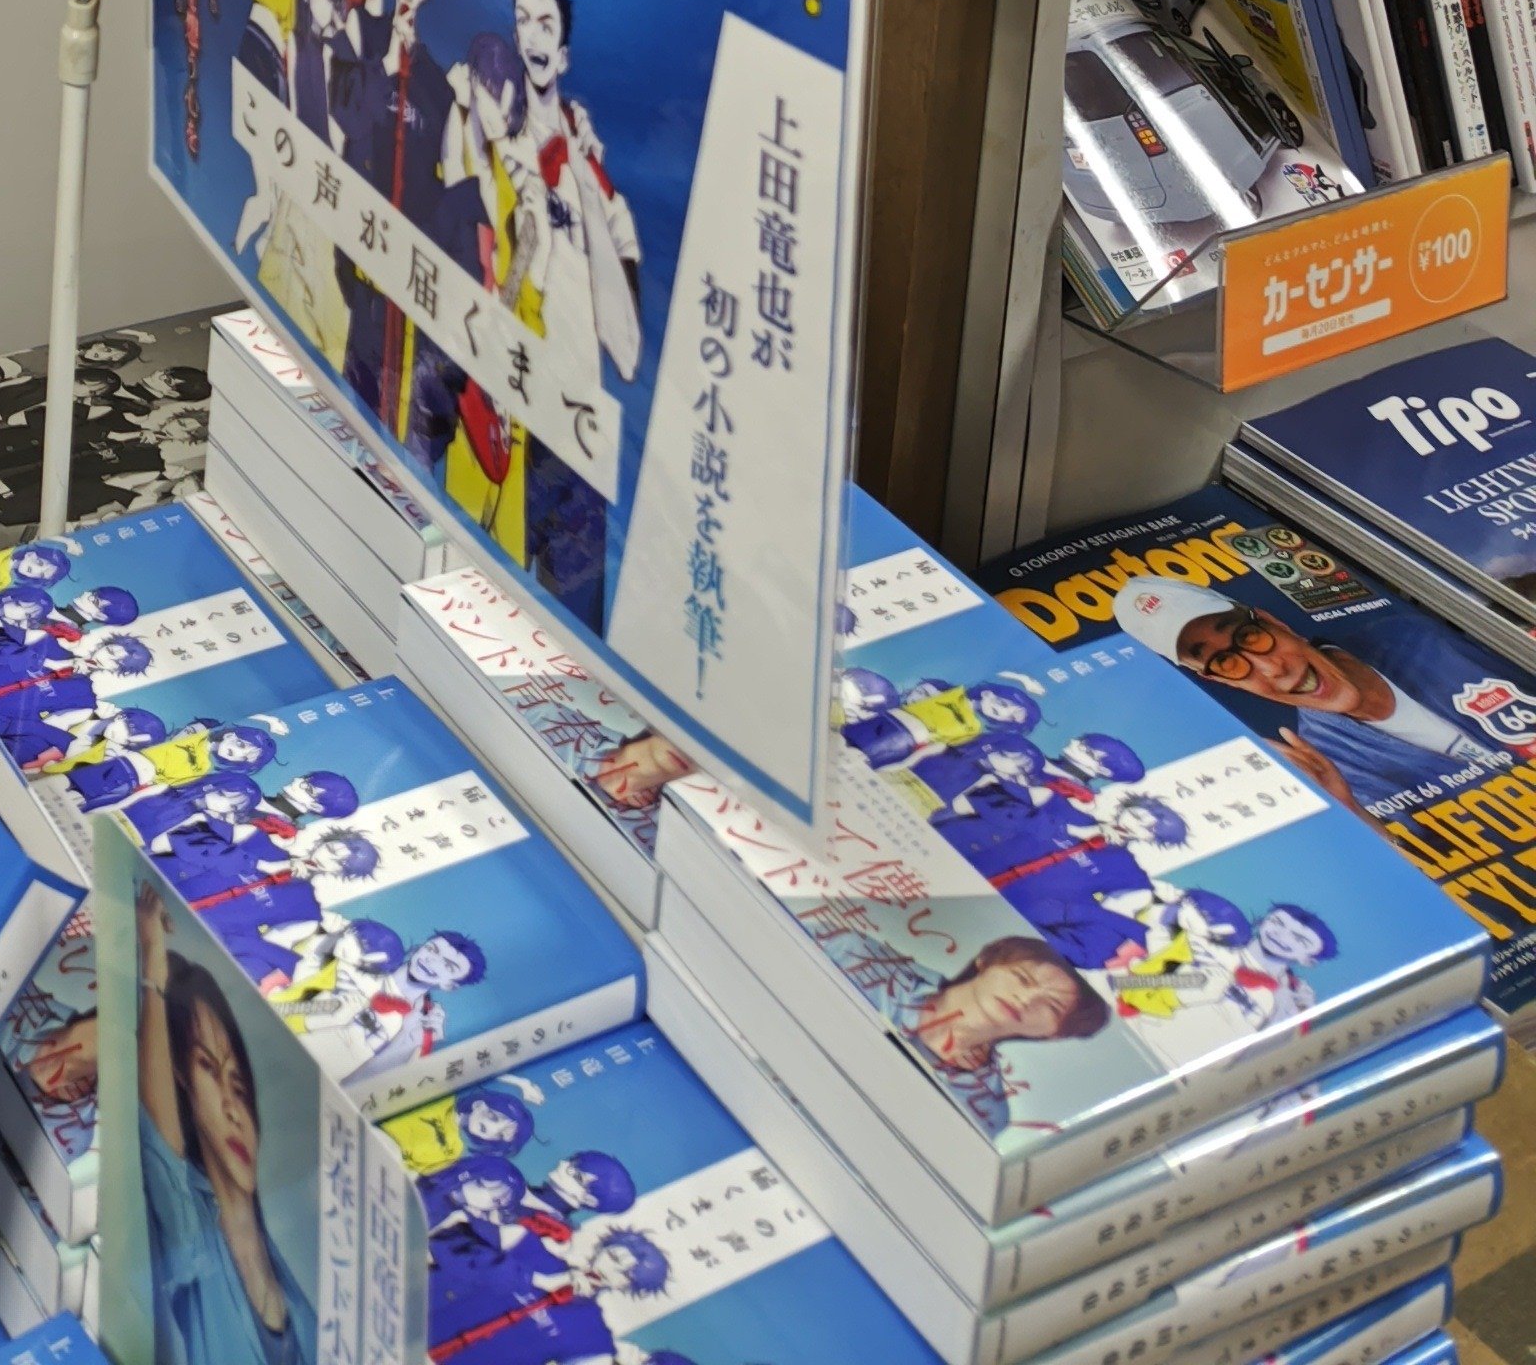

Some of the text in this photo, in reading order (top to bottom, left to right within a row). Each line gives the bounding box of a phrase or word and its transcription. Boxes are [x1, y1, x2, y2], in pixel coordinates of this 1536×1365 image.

[749, 95, 804, 373] 上田竜也が
[240, 93, 599, 463] この声が届くまで
[1262, 243, 1394, 327] カーセンサー
[1300, 312, 1356, 340] 毎月20日発売
[1366, 387, 1521, 457] Tipo
[685, 271, 741, 700] 初の小説を執筆!
[1087, 520, 1150, 549] SETAGAYA
[1146, 514, 1182, 533] BASE
[1476, 688, 1506, 712] ROUTE
[1496, 703, 1536, 733] 66
[377, 782, 486, 836] 届くまで
[1364, 749, 1516, 821] ROUTE 66 Road Trip
[397, 809, 522, 867] この声が
[662, 1165, 774, 1233] 届くまで
[697, 1205, 809, 1272] この声が
